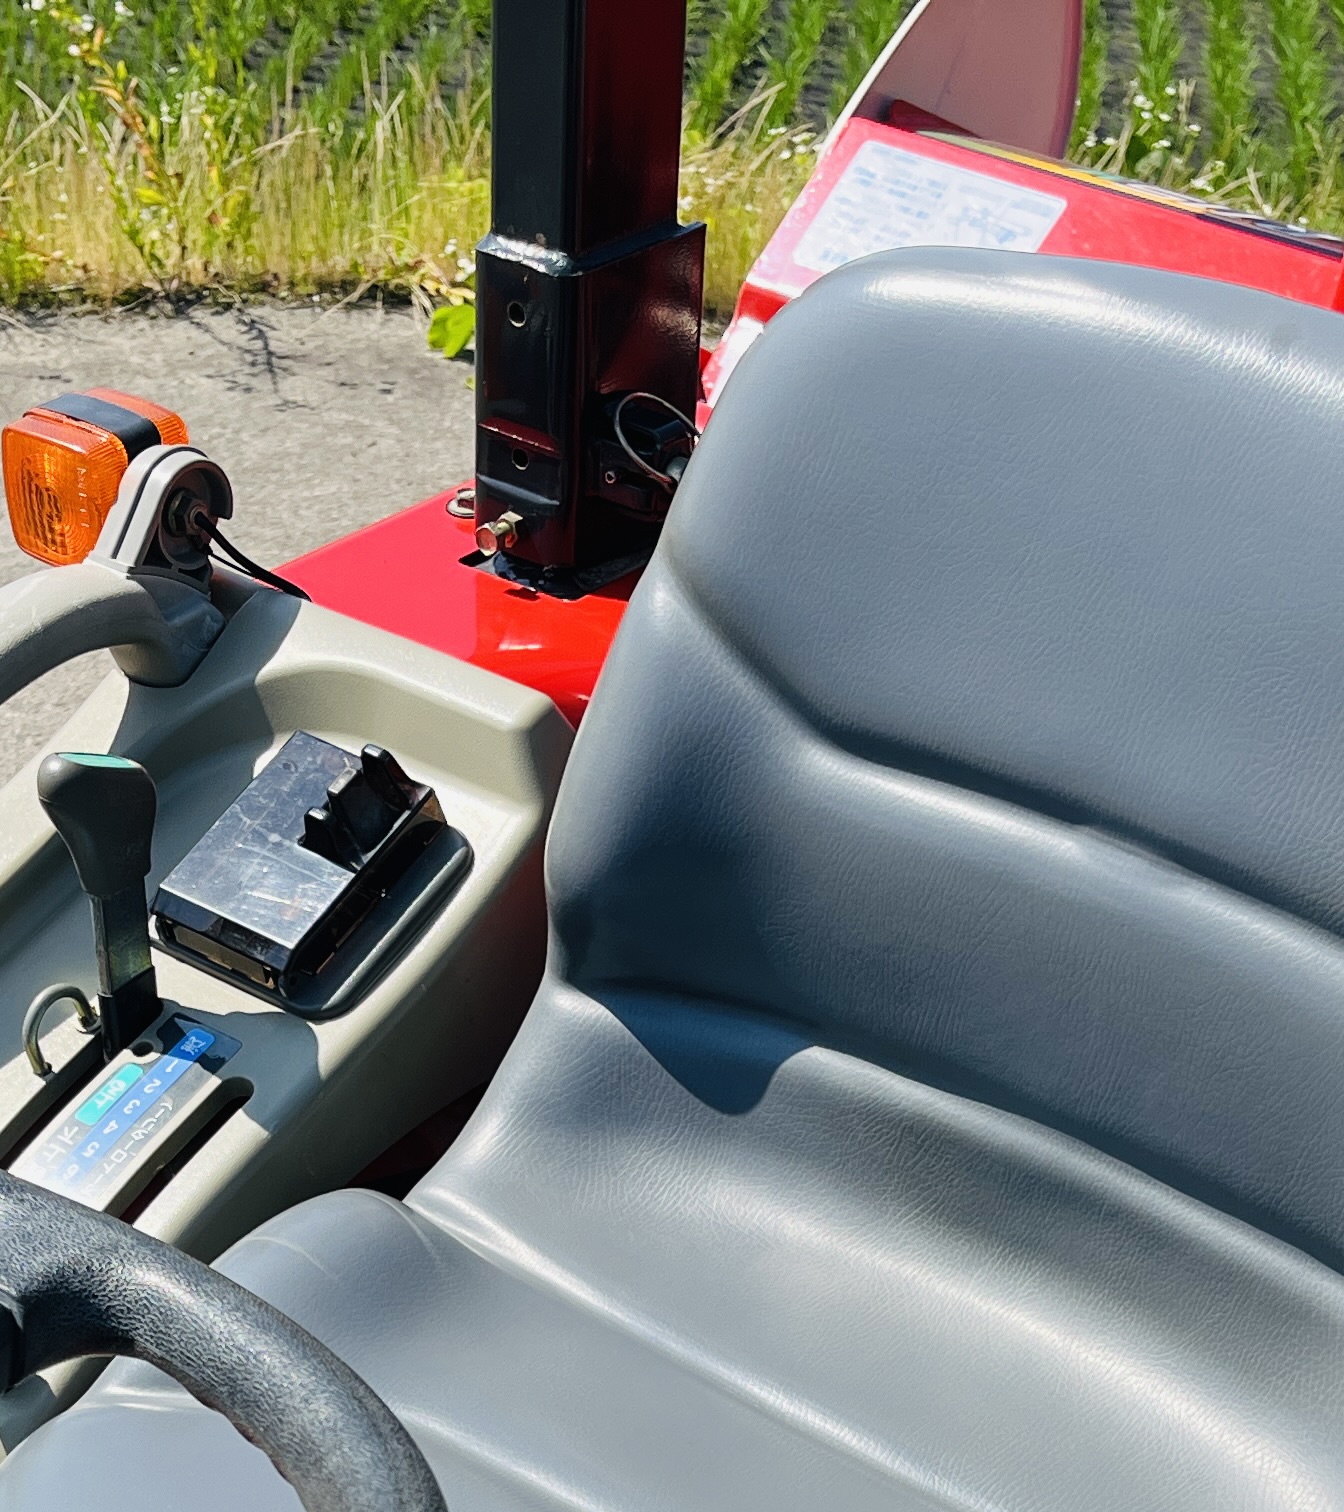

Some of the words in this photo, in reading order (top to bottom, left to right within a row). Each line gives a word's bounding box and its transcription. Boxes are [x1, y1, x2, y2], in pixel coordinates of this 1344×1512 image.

[144, 1079, 161, 1093] 2
[123, 1099, 140, 1114] 3
[103, 1120, 119, 1134] 4
[83, 1142, 99, 1157] 5
